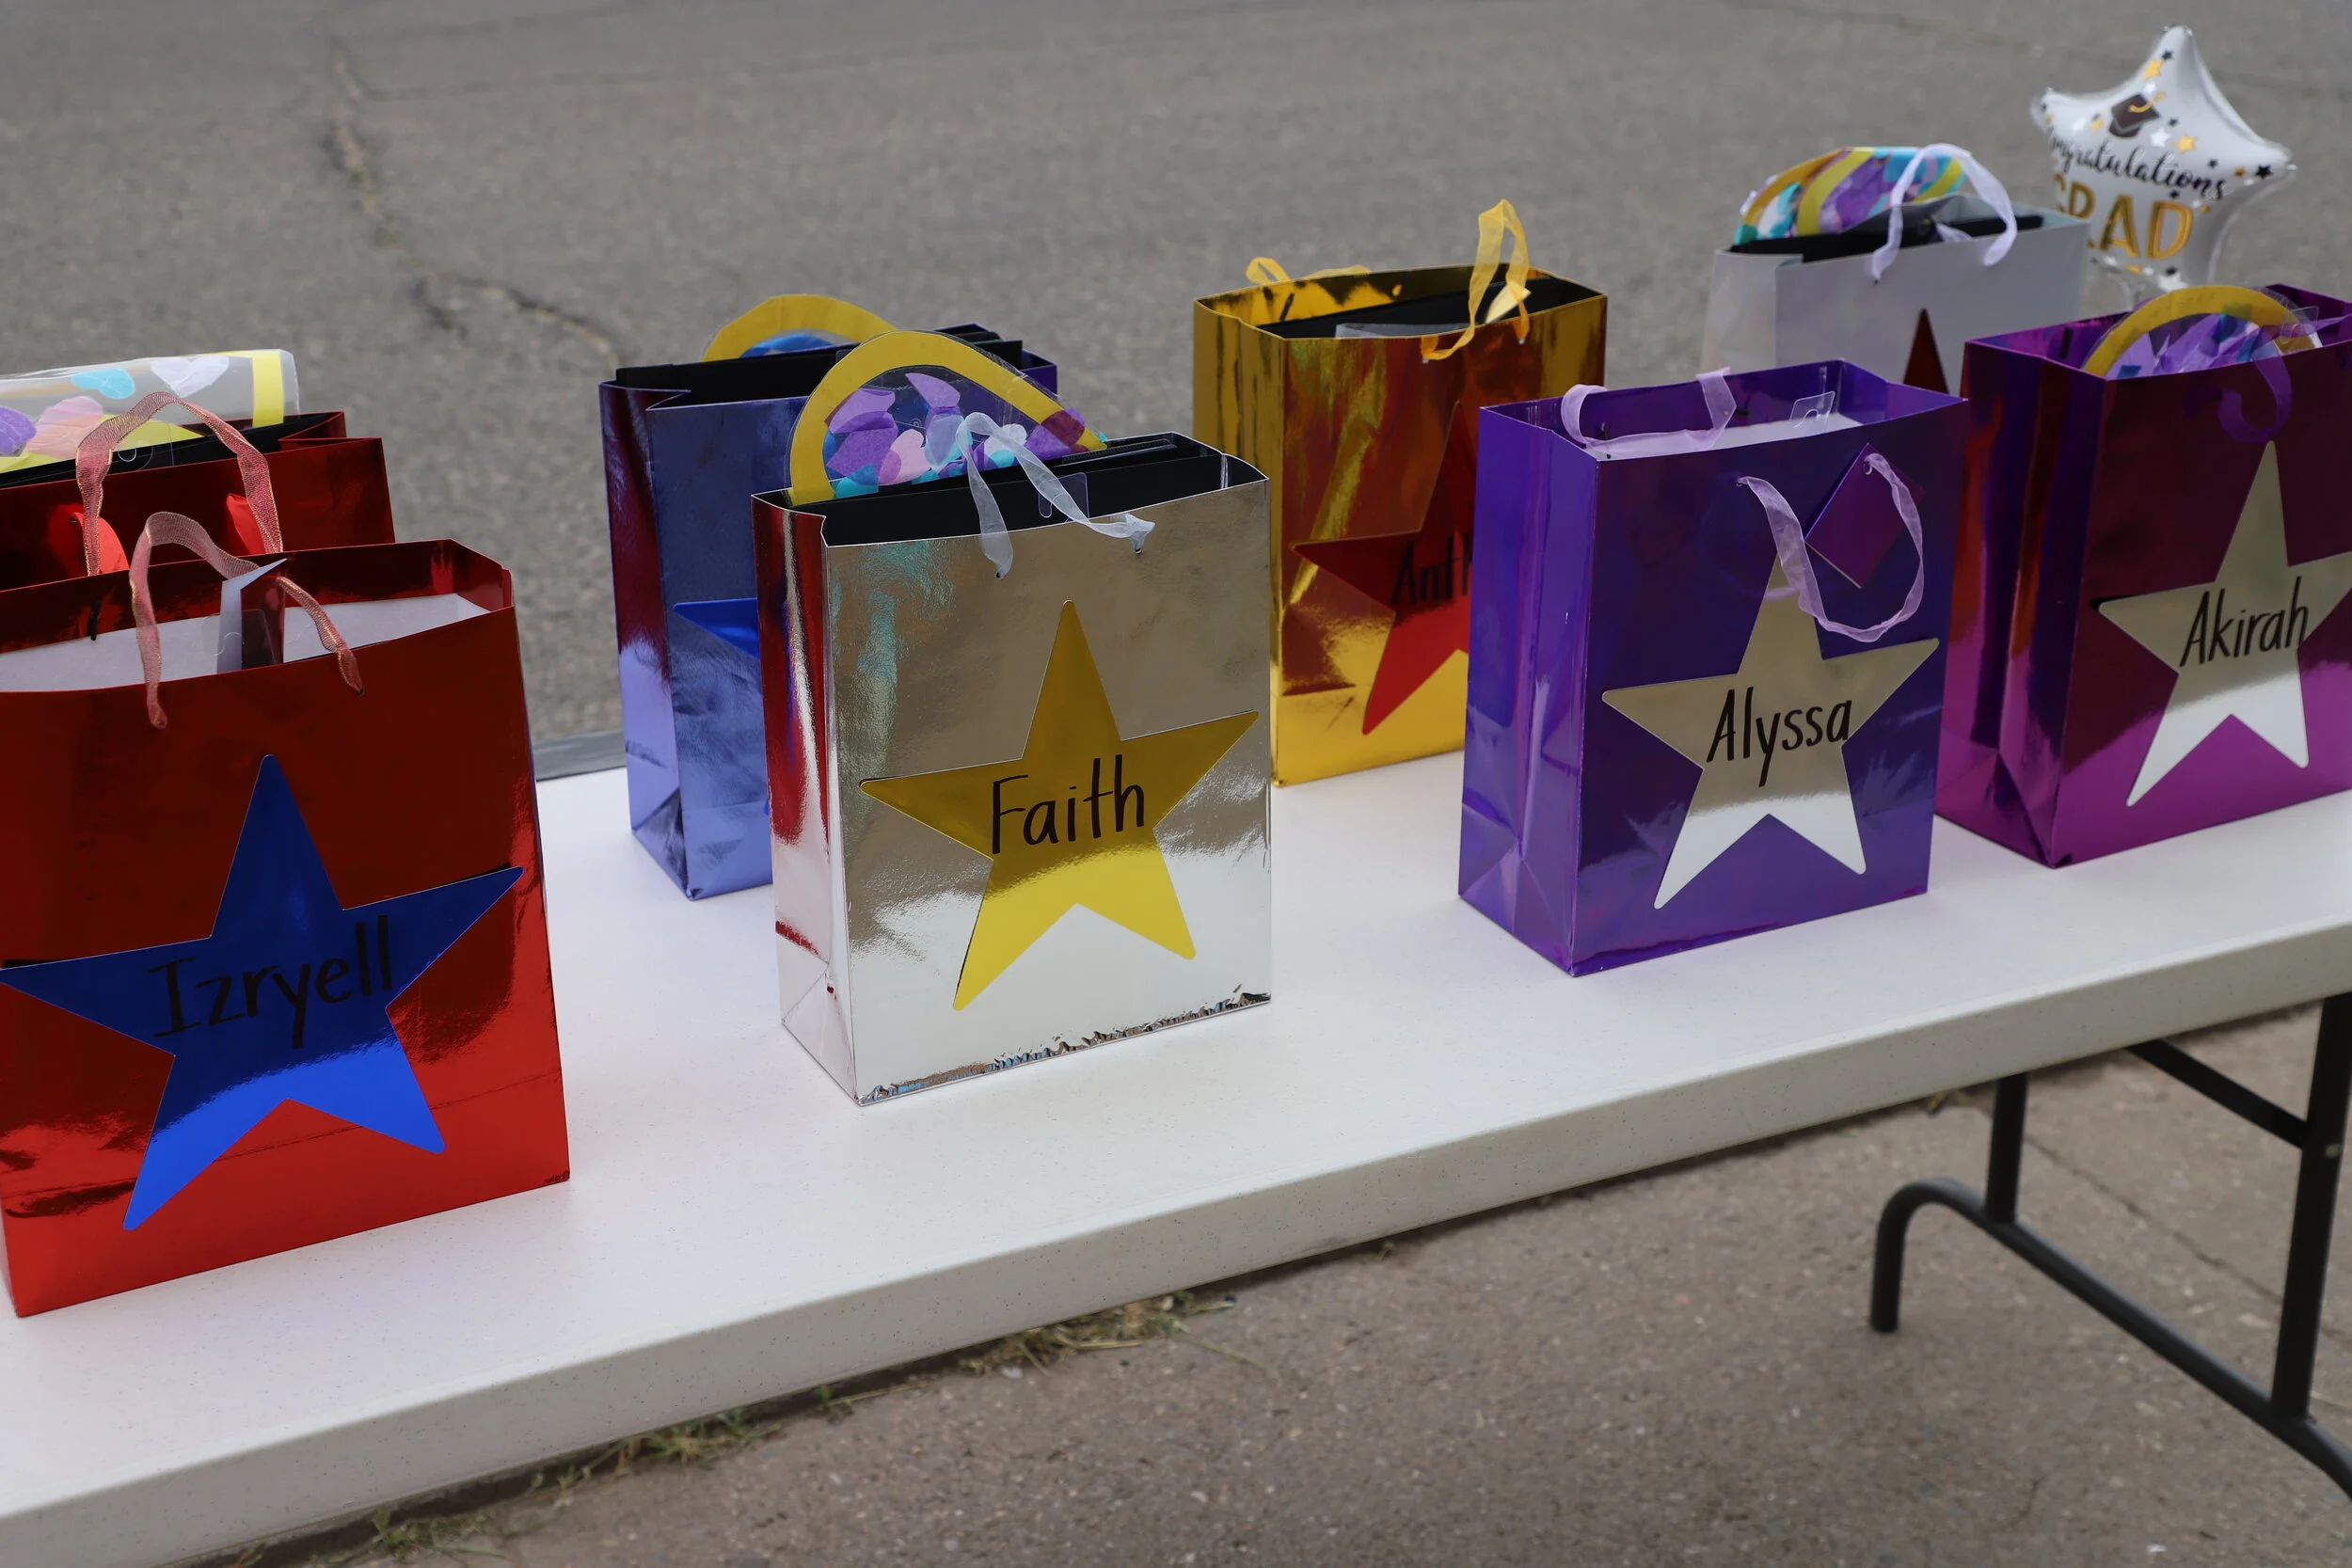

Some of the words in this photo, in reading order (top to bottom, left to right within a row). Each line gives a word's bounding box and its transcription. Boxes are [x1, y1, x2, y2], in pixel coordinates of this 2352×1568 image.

[2047, 125, 2229, 200] ongratulations
[2179, 576, 2309, 667] Akirah
[1706, 687, 1851, 787] Alyssa
[993, 754, 1144, 854] Faith
[148, 915, 392, 1050] Izryell
